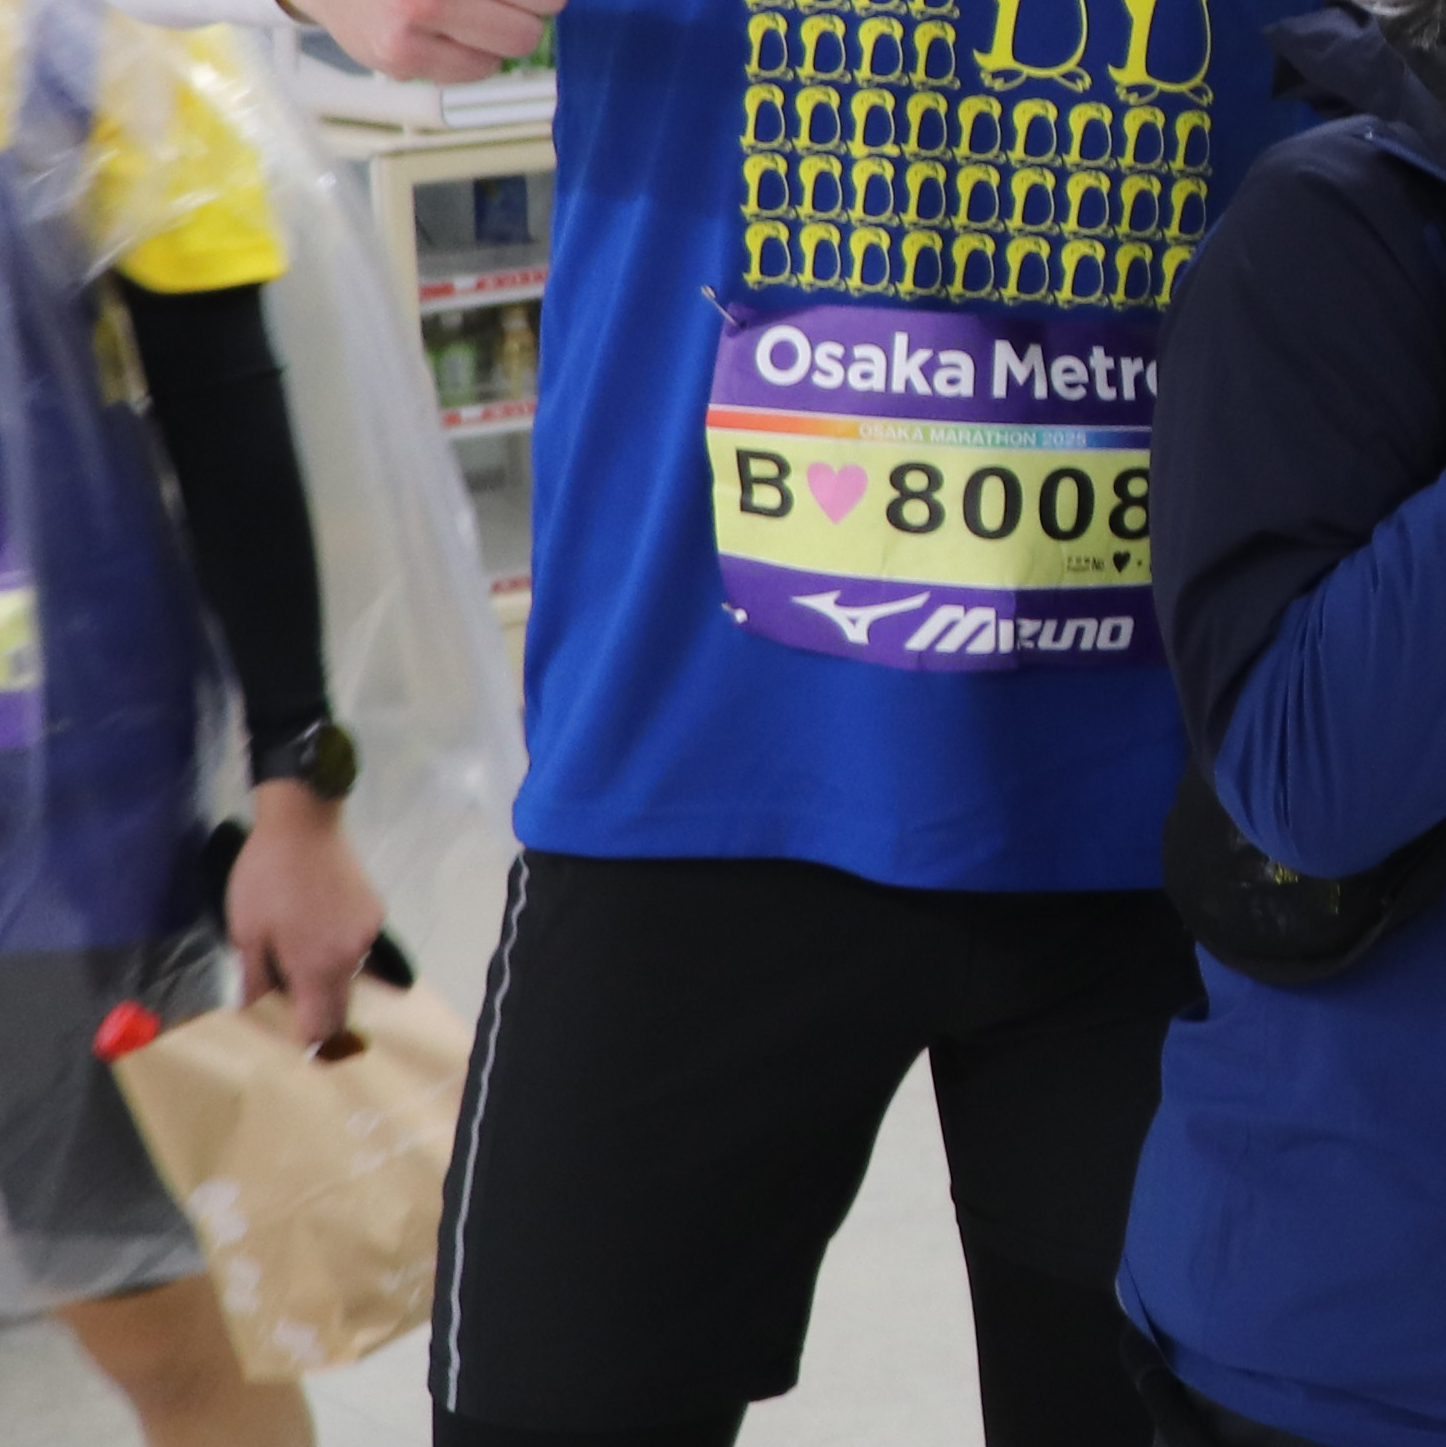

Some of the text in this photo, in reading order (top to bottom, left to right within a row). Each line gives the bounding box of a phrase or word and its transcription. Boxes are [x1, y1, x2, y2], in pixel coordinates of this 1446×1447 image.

[755, 325, 975, 398] Osaka
[858, 423, 1087, 448] OSAKA MARATHON 2025
[736, 449, 1150, 541] B 8008
